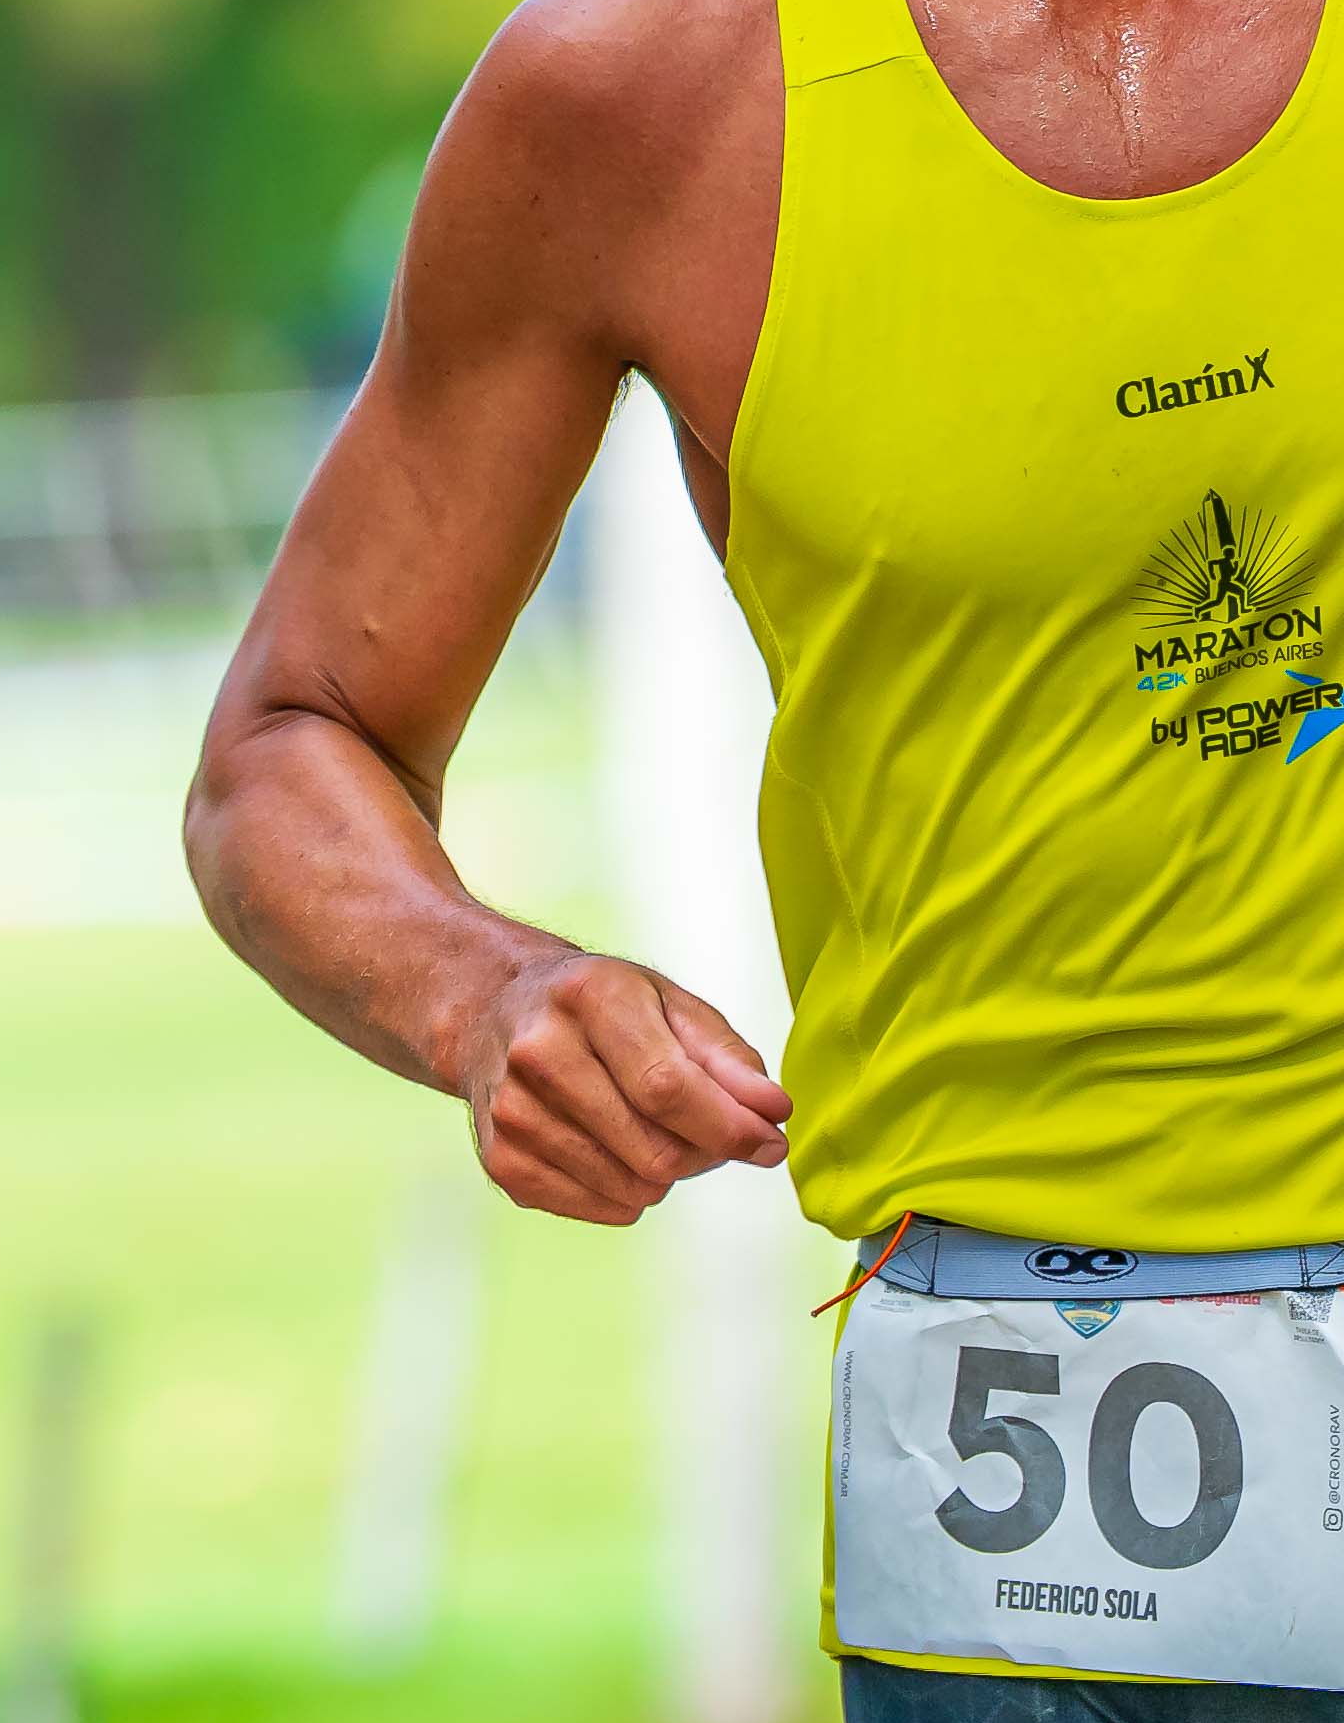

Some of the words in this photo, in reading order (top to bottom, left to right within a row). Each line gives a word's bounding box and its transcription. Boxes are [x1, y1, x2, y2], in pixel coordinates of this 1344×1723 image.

[1134, 605, 1323, 672] MARATON
[1136, 672, 1188, 693] 42K
[1194, 649, 1268, 684] BUENOS
[1272, 641, 1324, 664] AIRES
[1150, 716, 1188, 746] by
[1196, 682, 1344, 734] POWER
[1200, 720, 1282, 761] ADE
[933, 1344, 1245, 1570] 50
[1328, 1404, 1342, 1505] @CRONORAV
[995, 1578, 1099, 1617] FEDERICO
[1103, 1588, 1158, 1622] SOLA
